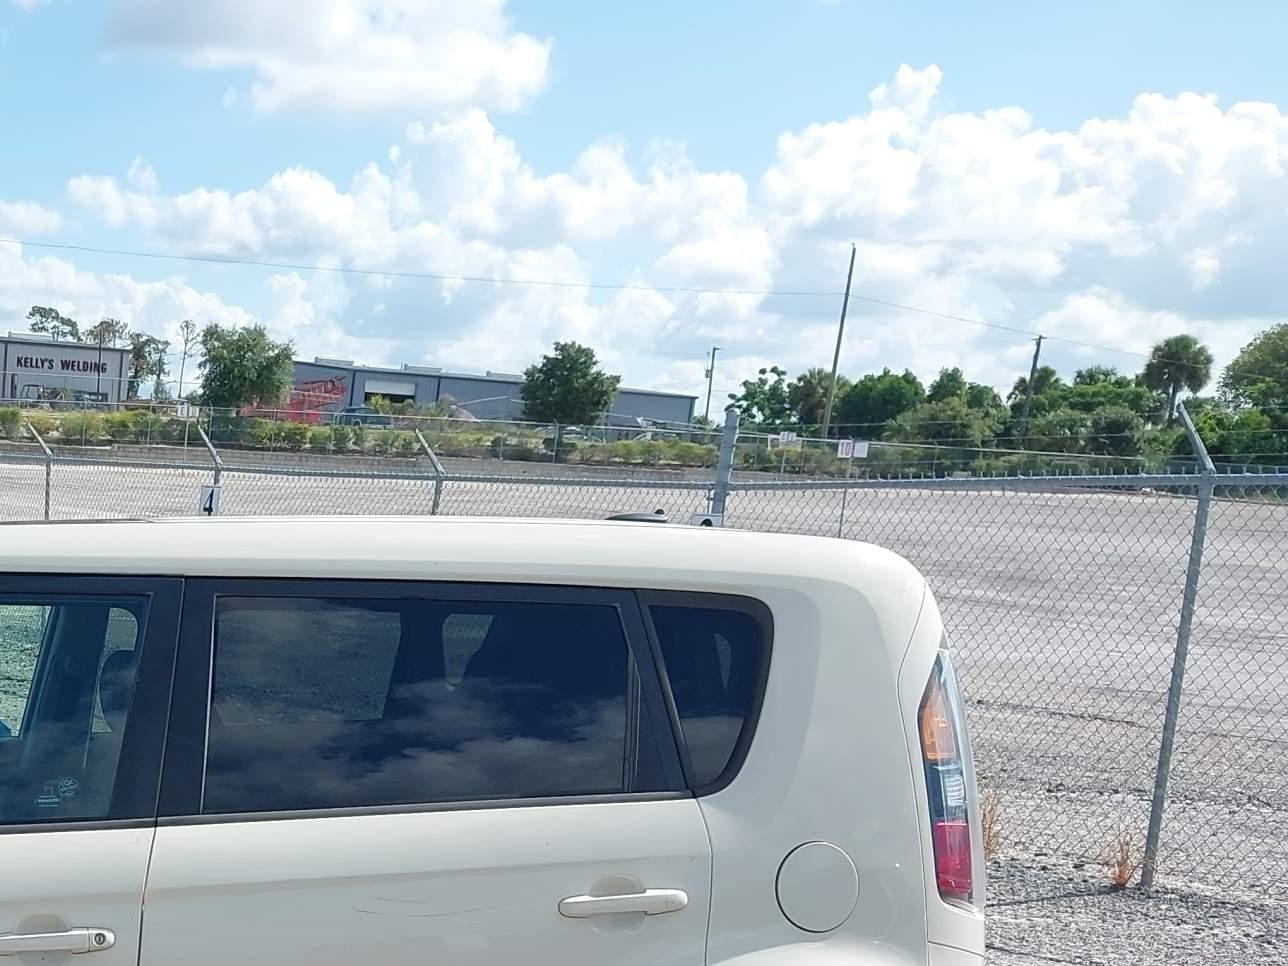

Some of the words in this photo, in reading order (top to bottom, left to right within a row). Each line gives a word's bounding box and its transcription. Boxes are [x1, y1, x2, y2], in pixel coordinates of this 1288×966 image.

[16, 356, 54, 370] KELLY'S
[60, 359, 108, 374] WELDING
[840, 442, 851, 457] 10
[202, 489, 214, 516] 4
